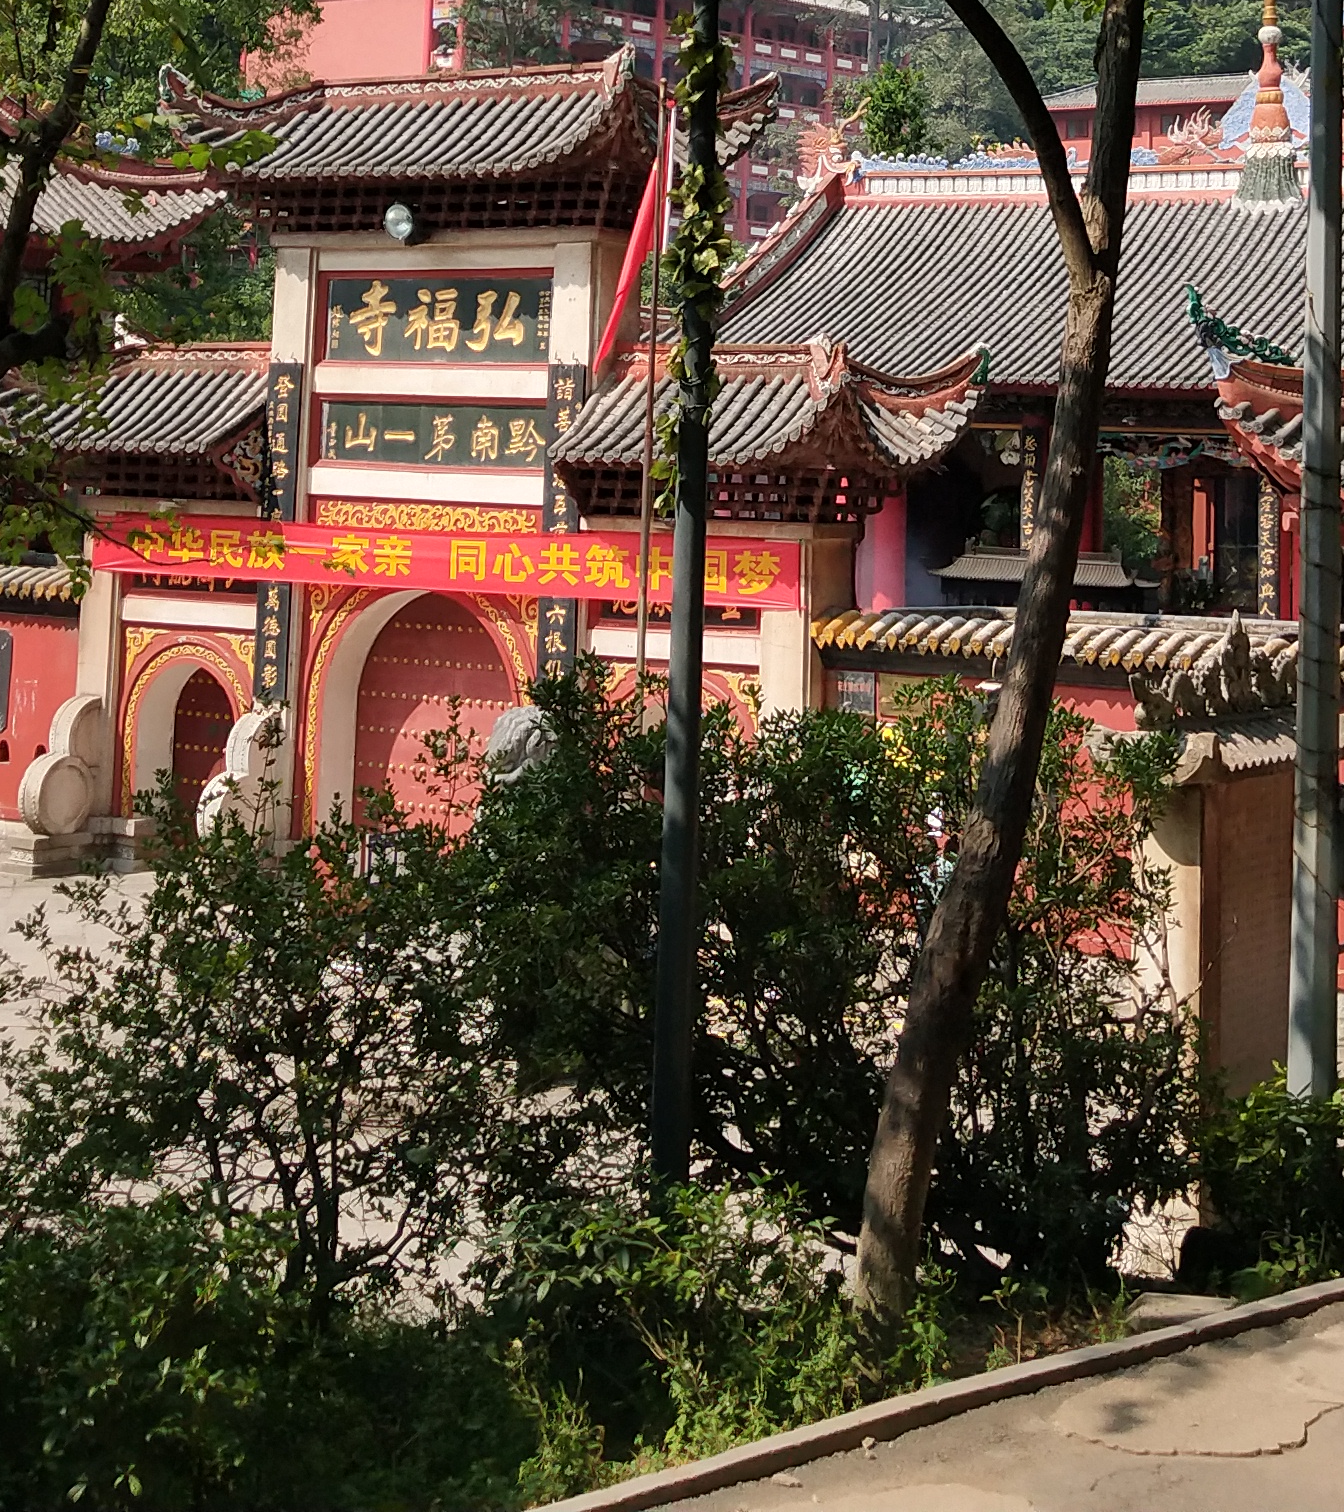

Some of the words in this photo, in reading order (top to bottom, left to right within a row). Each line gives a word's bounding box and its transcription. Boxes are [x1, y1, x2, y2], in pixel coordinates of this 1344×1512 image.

[349, 280, 525, 356] 弘福寺
[131, 525, 413, 577] 中华民族一家亲
[449, 539, 782, 595] 同心共筑中国梦
